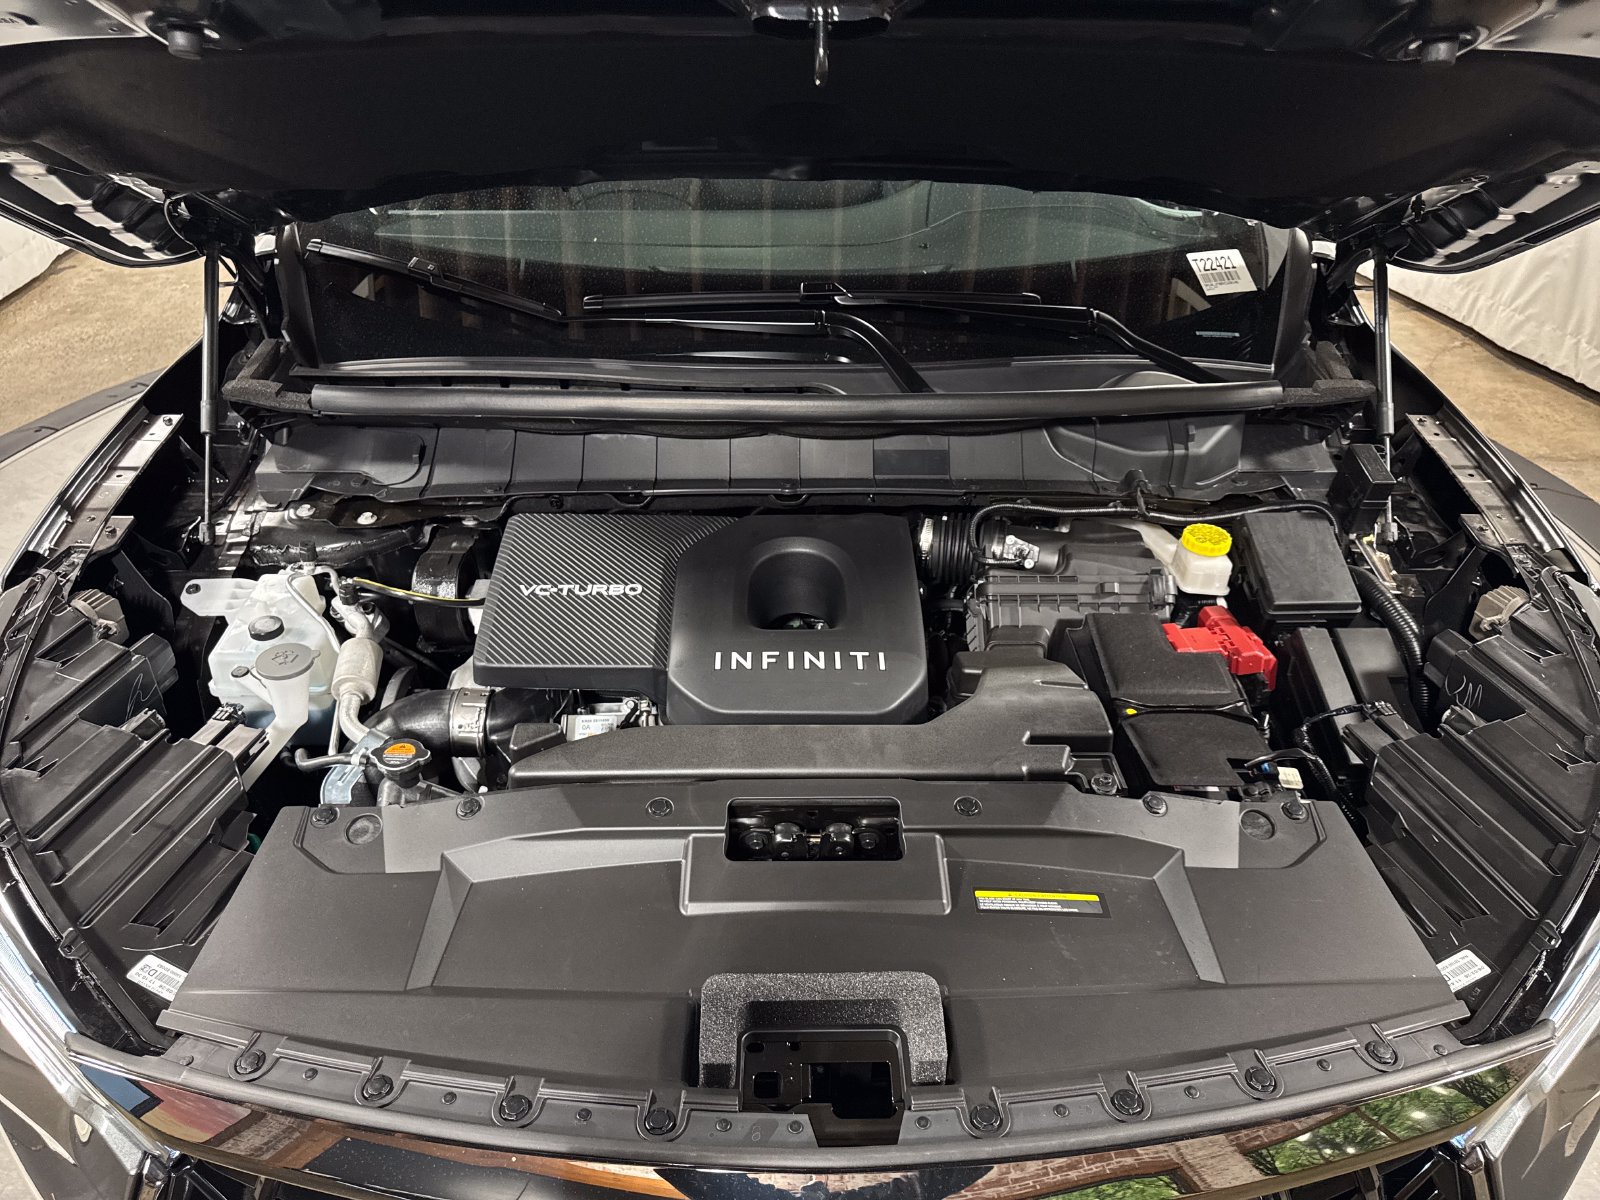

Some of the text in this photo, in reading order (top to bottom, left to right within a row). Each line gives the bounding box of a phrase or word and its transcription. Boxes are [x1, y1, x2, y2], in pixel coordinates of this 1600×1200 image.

[1192, 256, 1237, 272] T22421
[519, 584, 643, 596] VC-TURBO
[714, 651, 886, 670] INFINITI
